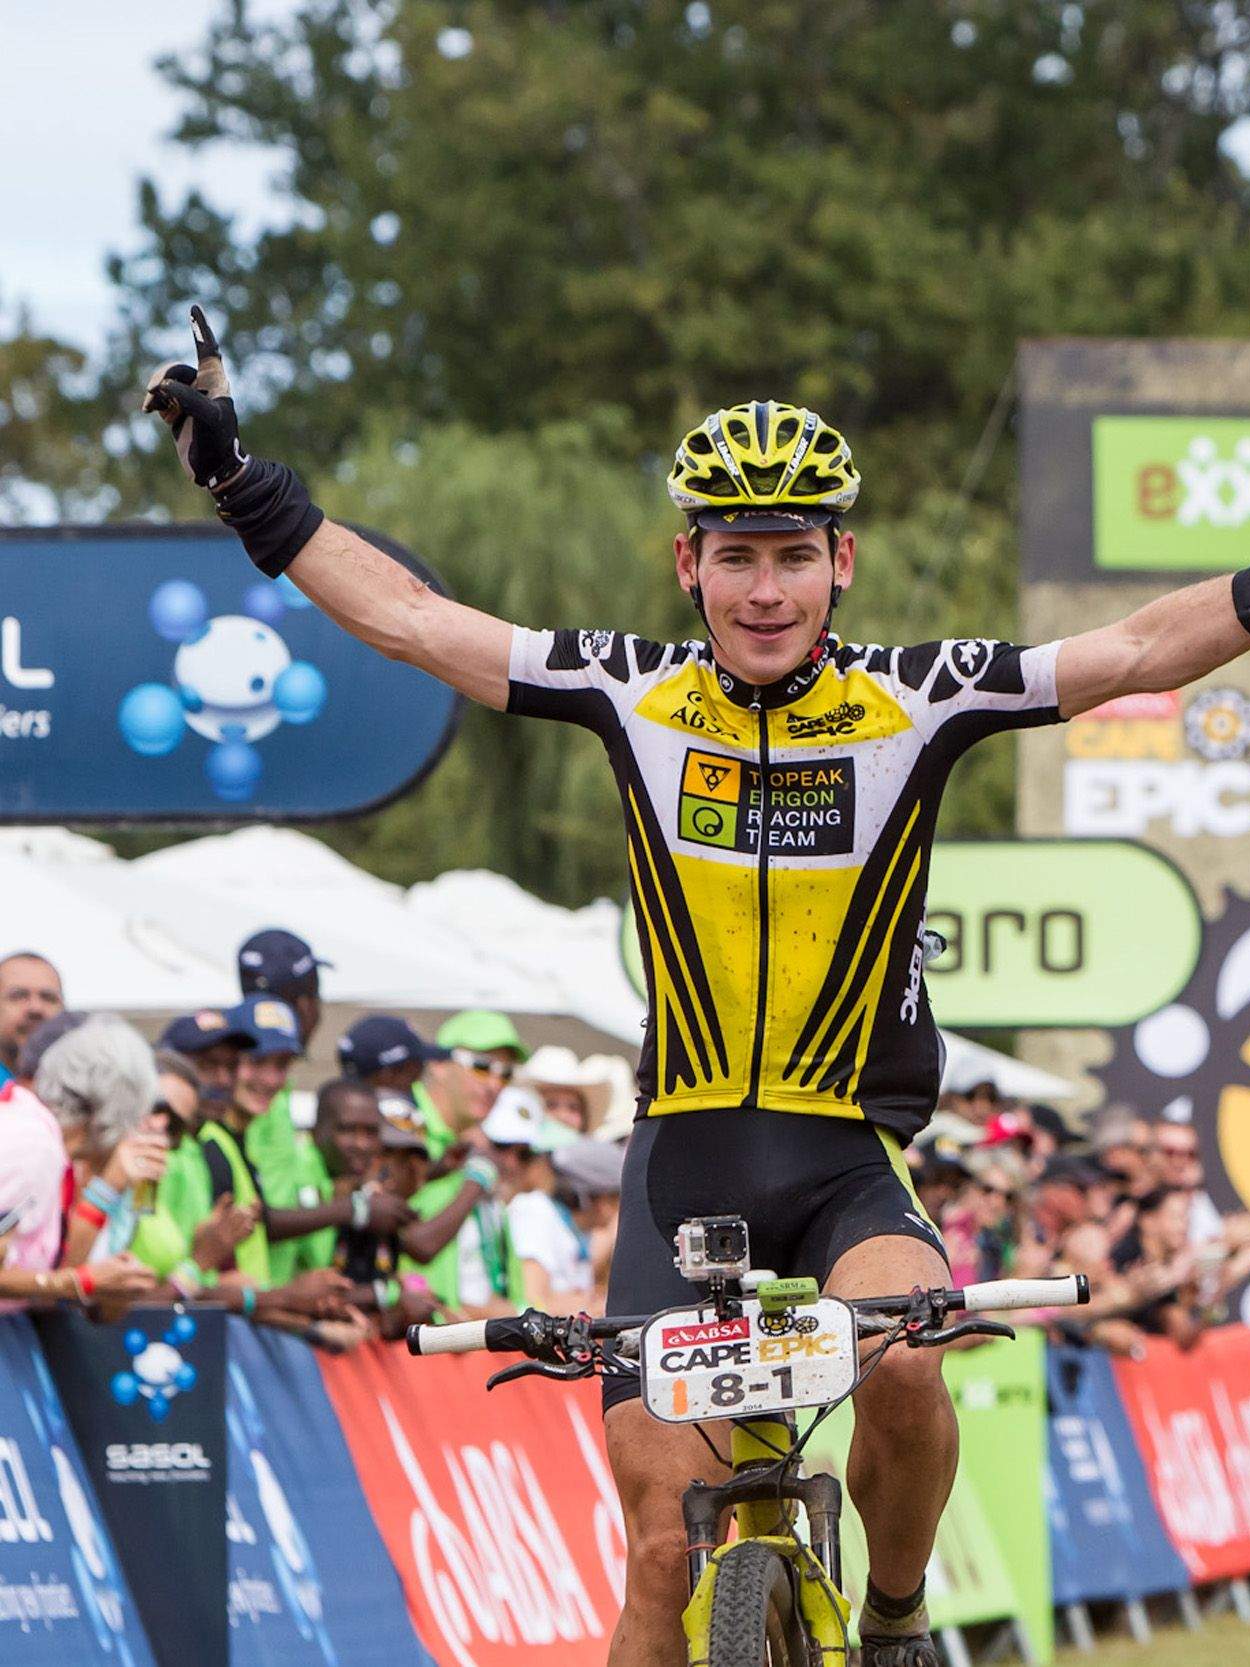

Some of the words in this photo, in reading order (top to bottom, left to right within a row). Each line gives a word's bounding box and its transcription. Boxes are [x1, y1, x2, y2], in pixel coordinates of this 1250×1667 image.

[750, 768, 844, 788] TOPEAK
[749, 789, 835, 807] ERGON
[747, 808, 842, 827] RACING
[745, 827, 816, 847] TEAM
[695, 1324, 744, 1341] ABSA
[660, 1341, 751, 1373] CAPE
[757, 1333, 839, 1363] EPIC
[710, 1366, 794, 1406] 8-1
